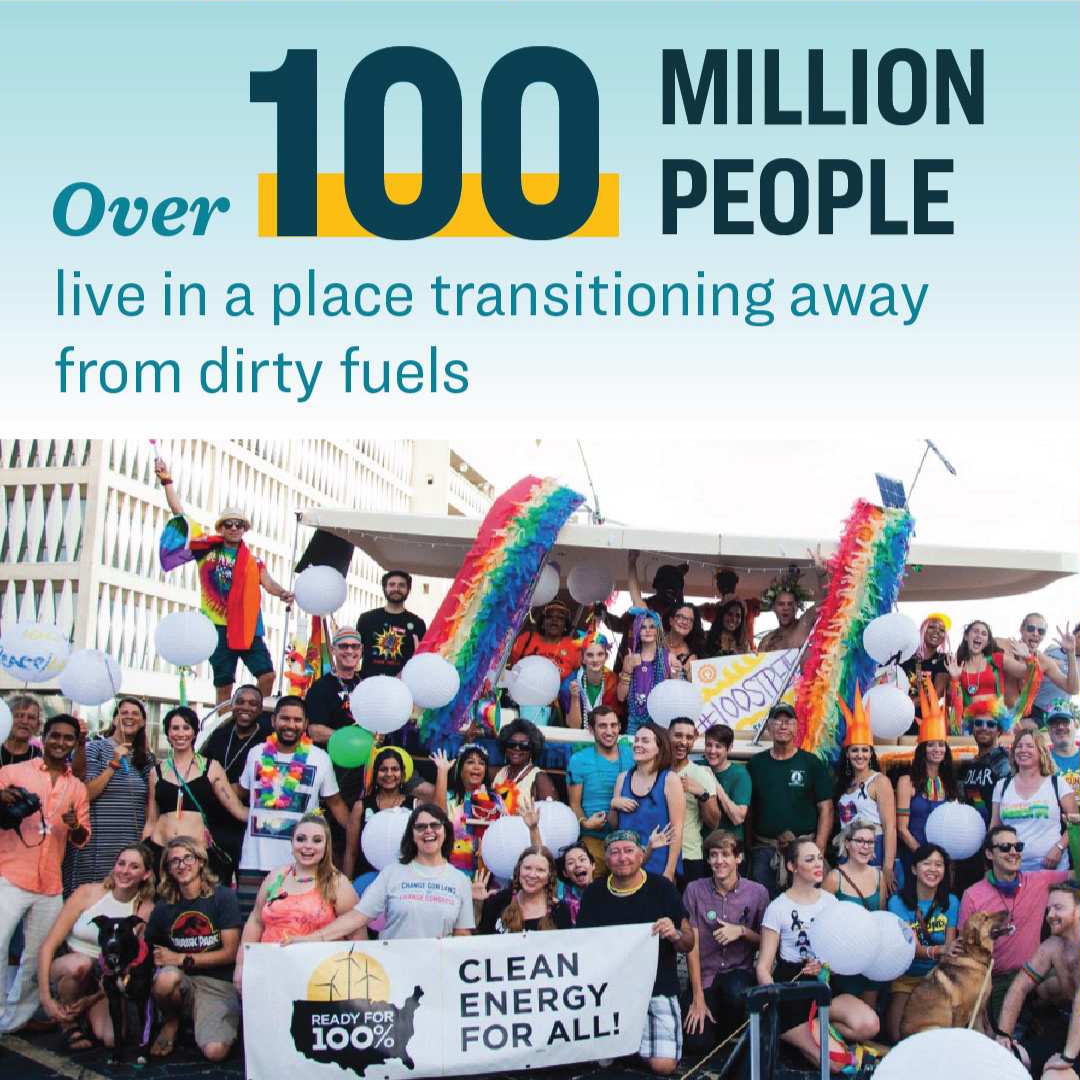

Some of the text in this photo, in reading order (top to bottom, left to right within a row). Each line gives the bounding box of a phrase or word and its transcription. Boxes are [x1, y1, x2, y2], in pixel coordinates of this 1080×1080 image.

[459, 952, 579, 983] CLEAN
[460, 982, 608, 1018] ENERGY
[311, 1011, 394, 1025] READY FOR
[461, 1012, 619, 1052] FOR ALL!
[312, 1024, 395, 1051] 100%
